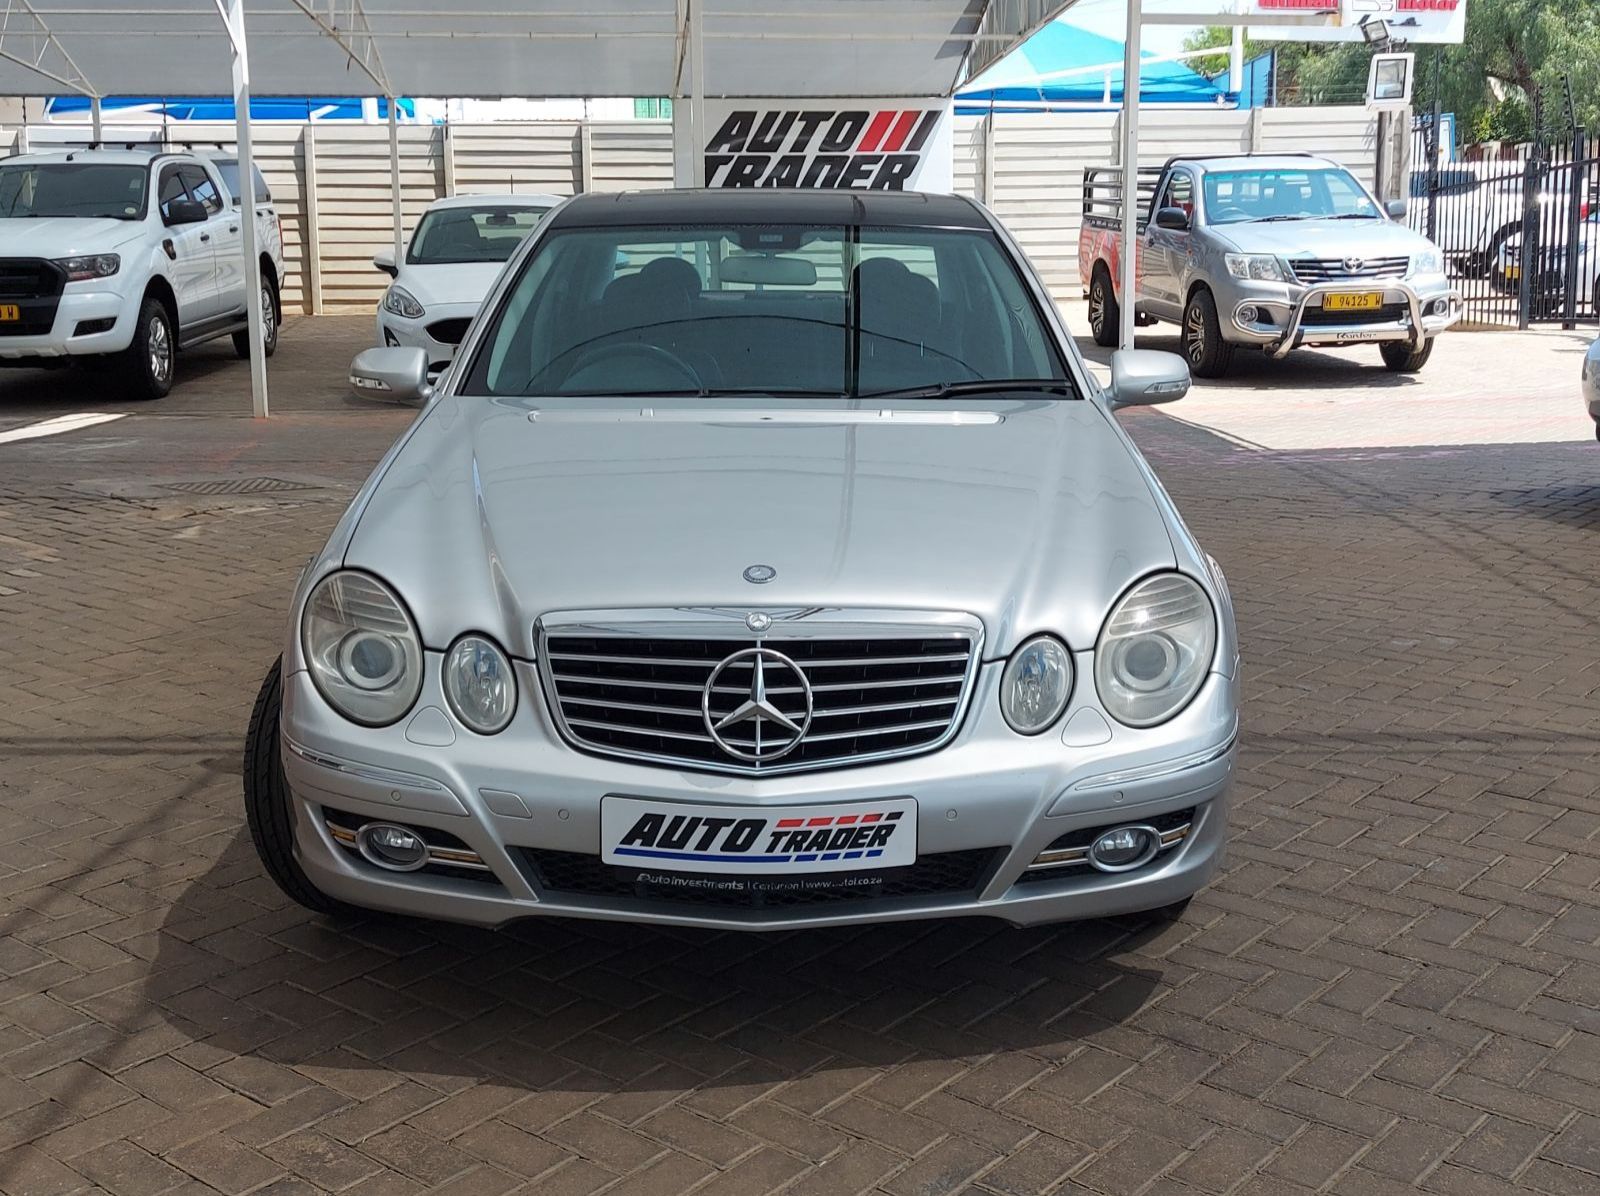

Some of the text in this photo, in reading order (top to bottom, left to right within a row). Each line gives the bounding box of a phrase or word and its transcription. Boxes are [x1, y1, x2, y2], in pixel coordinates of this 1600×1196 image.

[704, 110, 870, 153] AUTO
[704, 155, 921, 191] TRADER
[1326, 295, 1381, 307] N 94125 W
[619, 812, 897, 854] AUTO TRADER
